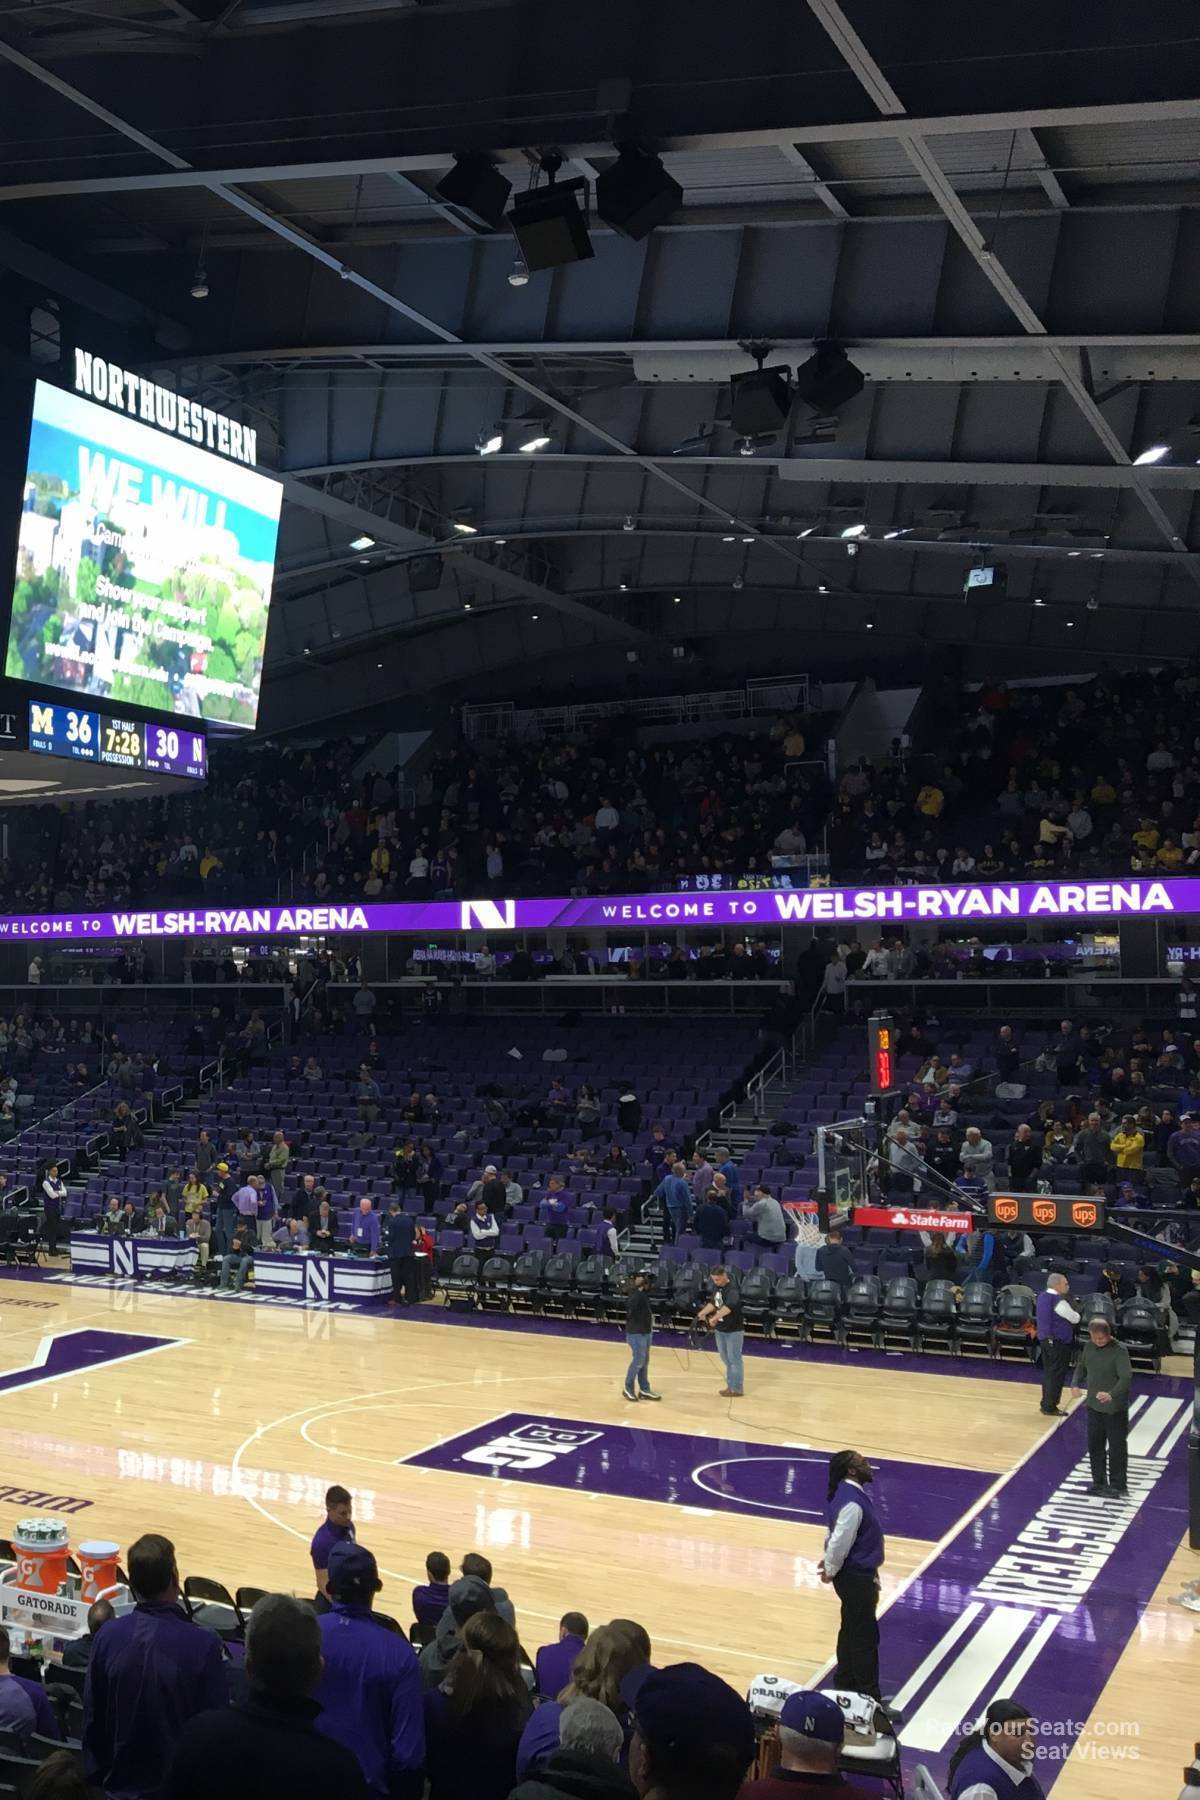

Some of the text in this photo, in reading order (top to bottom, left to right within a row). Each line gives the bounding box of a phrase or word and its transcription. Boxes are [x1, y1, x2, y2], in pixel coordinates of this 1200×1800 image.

[74, 347, 257, 466] NORTHWESTERN
[31, 704, 54, 735] M
[66, 711, 92, 744] 36
[112, 720, 136, 731] 1ST HALF
[106, 728, 140, 756] 7:28
[156, 729, 179, 760] 30
[192, 737, 202, 762] N
[102, 751, 134, 766] POSSESSION
[461, 900, 515, 929] N
[602, 882, 1175, 921] WELCOME TO WELSH-RYAN ARENA
[0, 908, 368, 935] WELCOME TO WELSH-RYAN ARENA
[997, 1204, 1016, 1219] ups
[1034, 1206, 1054, 1221] ups
[1074, 1208, 1094, 1224] ups
[112, 1240, 134, 1275] N
[305, 1259, 329, 1299] N
[21, 1559, 33, 1575] G
[83, 1566, 94, 1582] G
[17, 1594, 77, 1617] GATORADE
[804, 1716, 816, 1732] N
